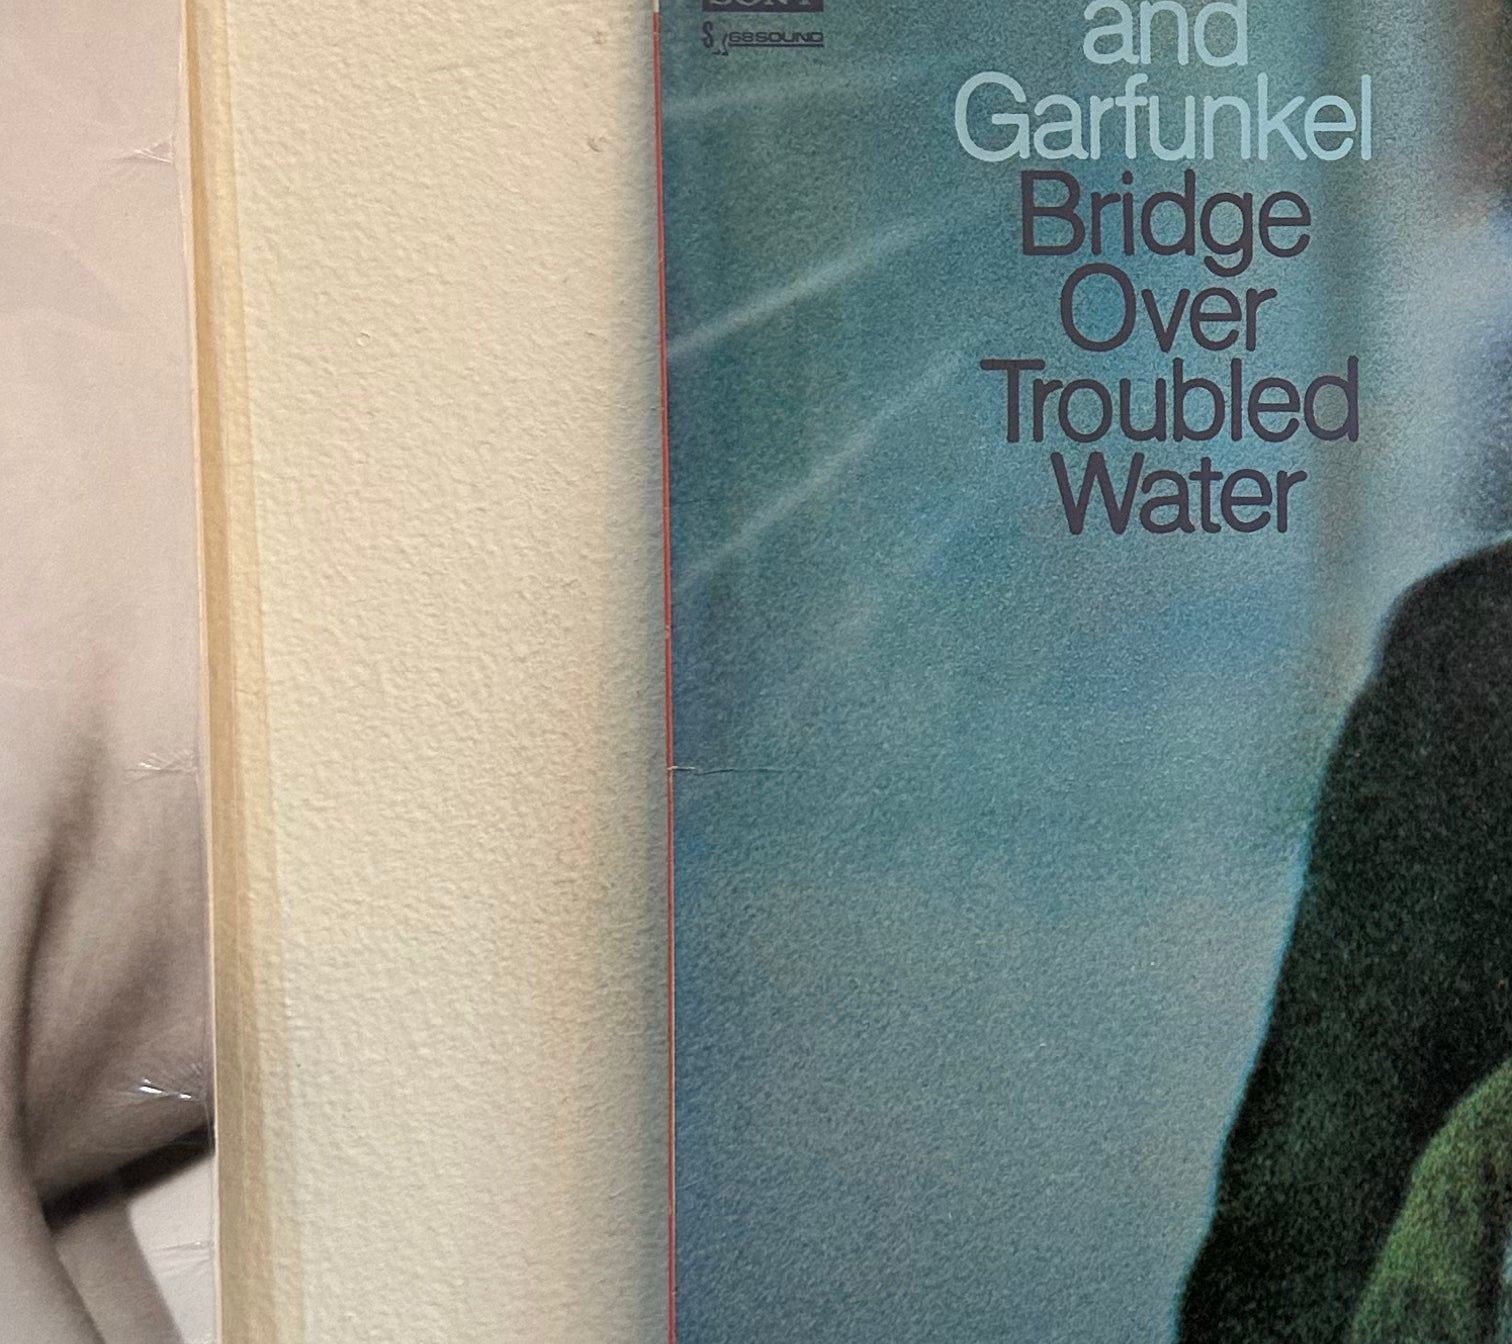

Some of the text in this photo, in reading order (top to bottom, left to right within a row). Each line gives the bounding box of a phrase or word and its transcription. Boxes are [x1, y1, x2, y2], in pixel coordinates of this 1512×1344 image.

[954, 71, 1373, 162] Garfunkel
[1020, 168, 1312, 278] Bridge
[1060, 262, 1278, 353] Over
[979, 355, 1360, 444] Troubled
[1050, 451, 1308, 536] Water
